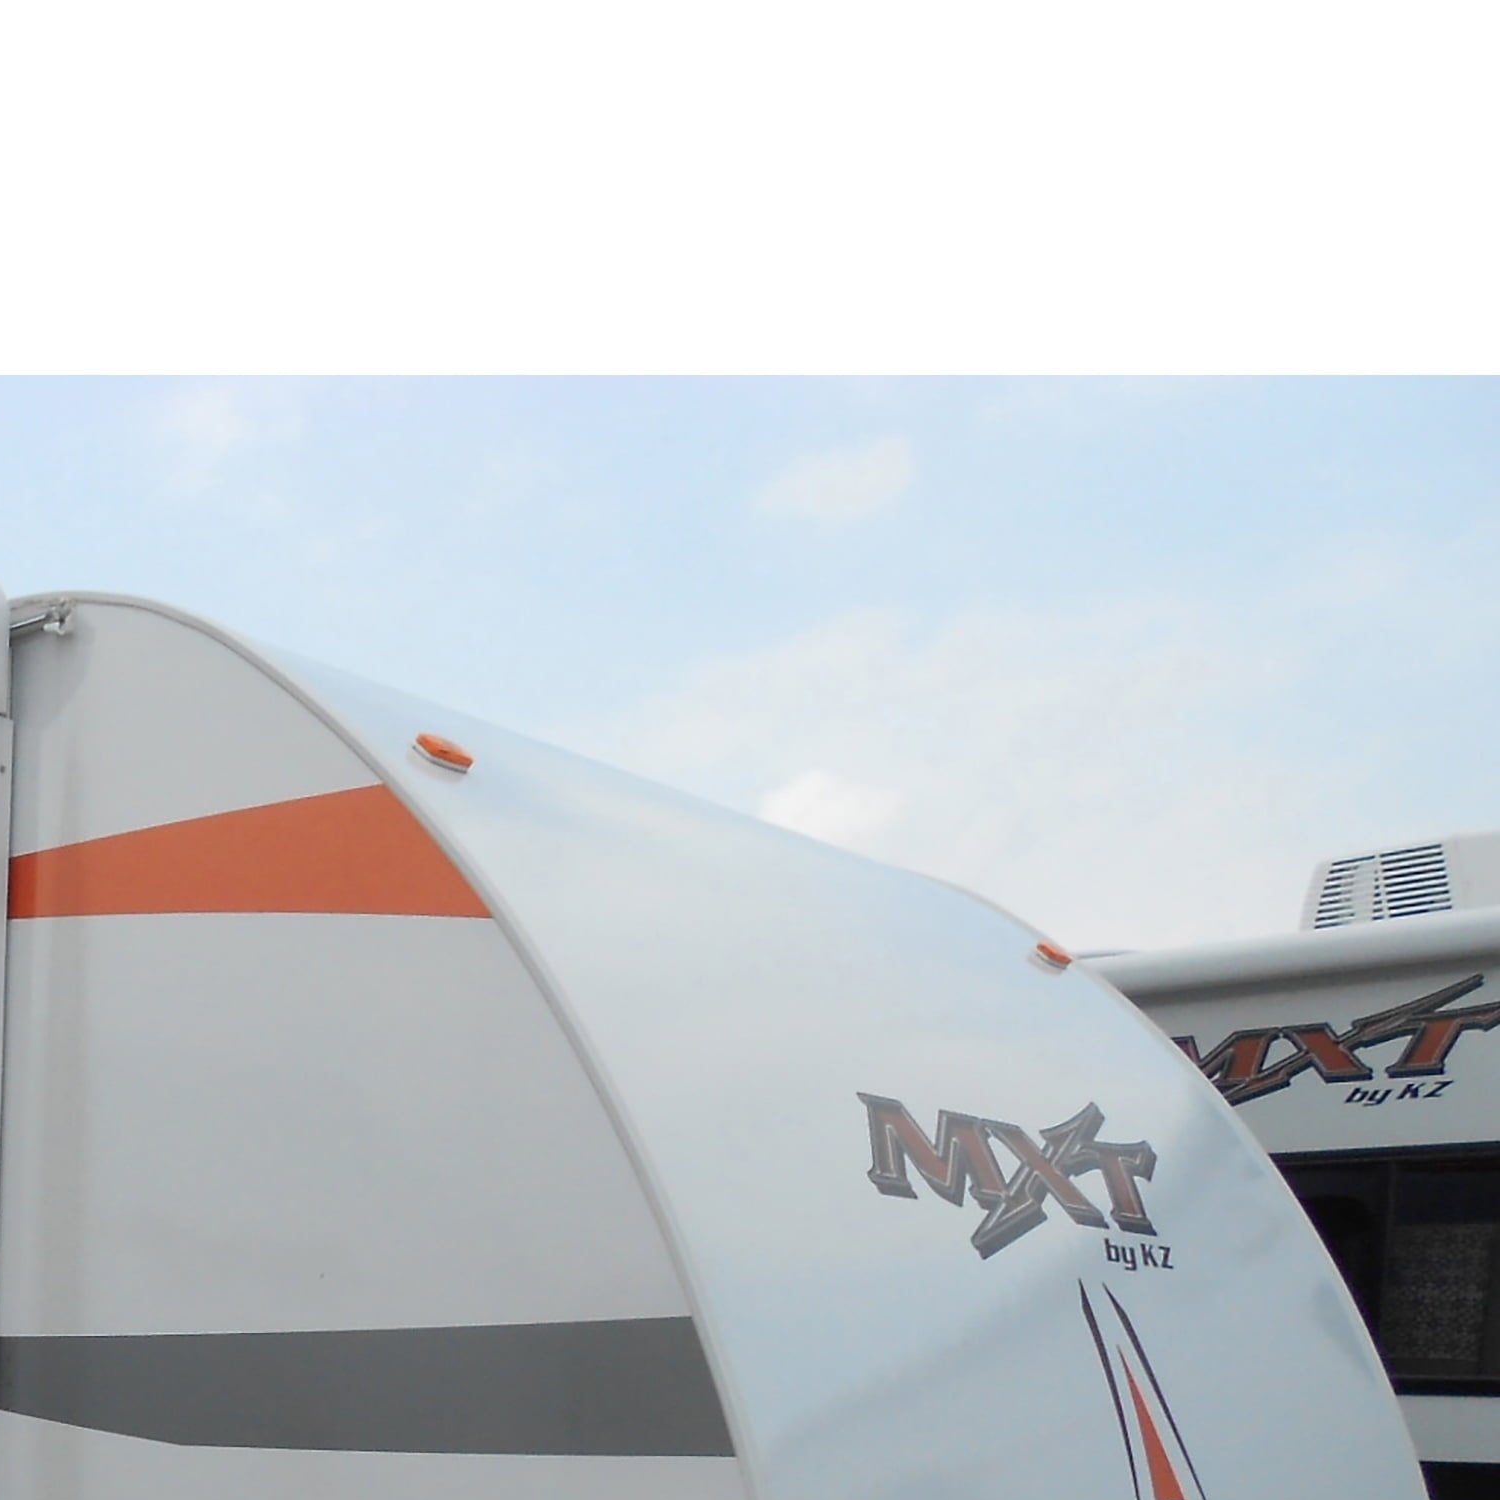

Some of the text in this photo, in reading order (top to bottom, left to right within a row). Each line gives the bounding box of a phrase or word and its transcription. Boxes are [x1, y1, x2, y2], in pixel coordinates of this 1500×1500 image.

[1344, 1080, 1454, 1107] by KZ
[856, 1091, 1158, 1260] MXT
[1104, 1238, 1174, 1271] by KZ
